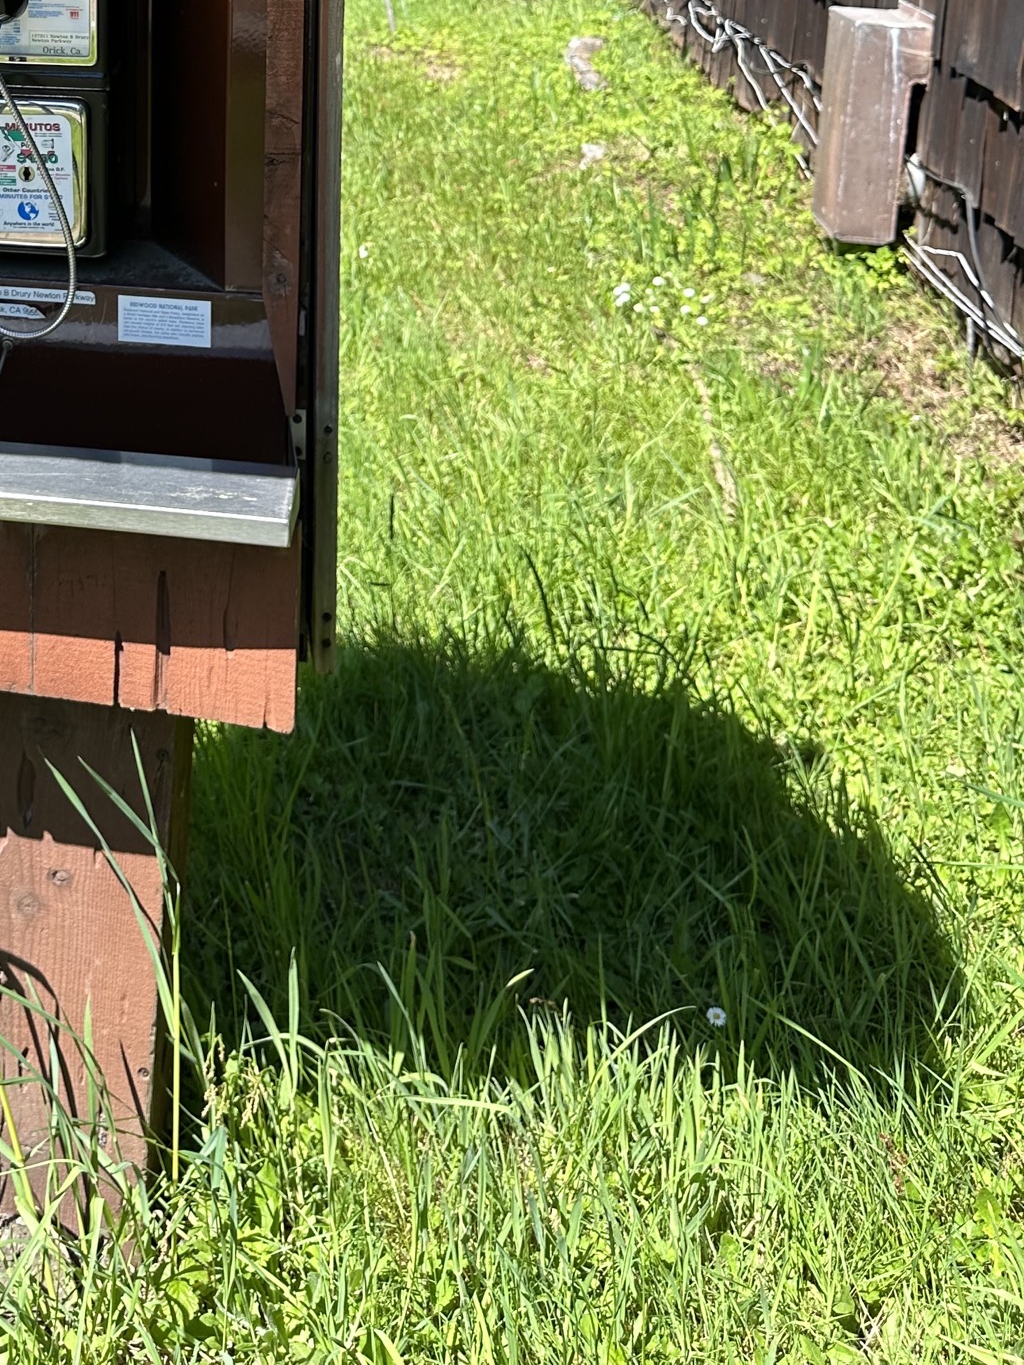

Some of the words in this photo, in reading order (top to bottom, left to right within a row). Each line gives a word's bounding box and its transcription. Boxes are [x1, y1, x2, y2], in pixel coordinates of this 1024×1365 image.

[42, 46, 68, 55] Orick,
[11, 289, 31, 298] Drury
[33, 291, 60, 299] Newton
[63, 292, 95, 302] Pkway
[130, 301, 157, 309] REDWOOD
